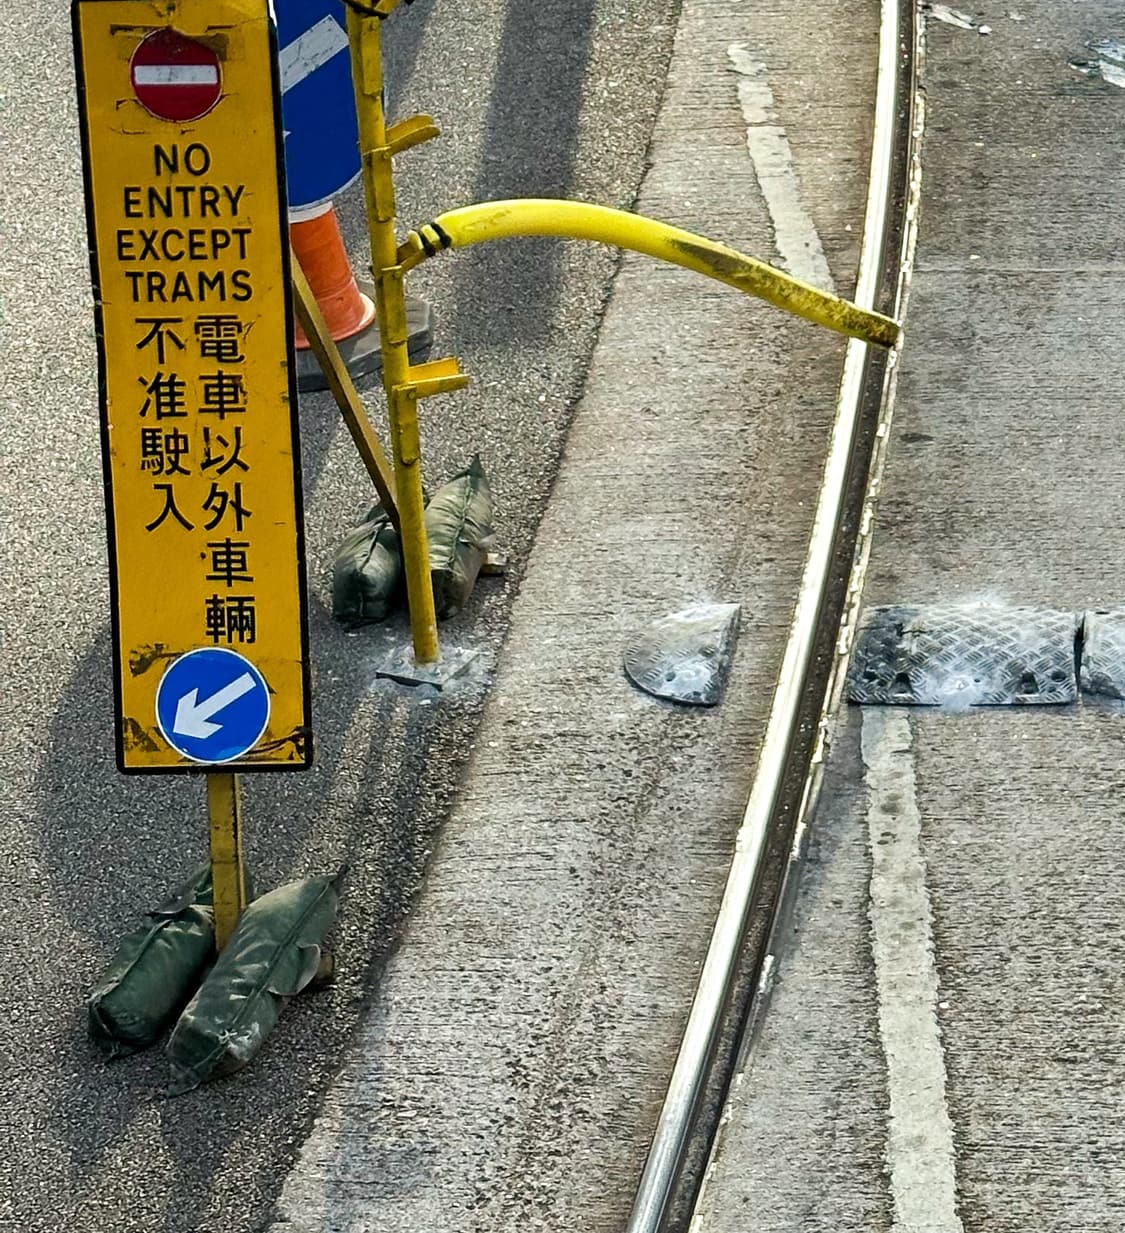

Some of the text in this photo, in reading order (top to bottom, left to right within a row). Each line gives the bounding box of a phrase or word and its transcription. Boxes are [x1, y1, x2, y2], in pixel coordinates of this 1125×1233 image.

[154, 143, 211, 176] NO
[124, 184, 245, 218] ENTRY
[116, 228, 252, 261] EXCEPT
[125, 270, 253, 303] TRAMS
[135, 317, 194, 532] 不准駛入
[195, 314, 256, 644] 電車以外車輛
